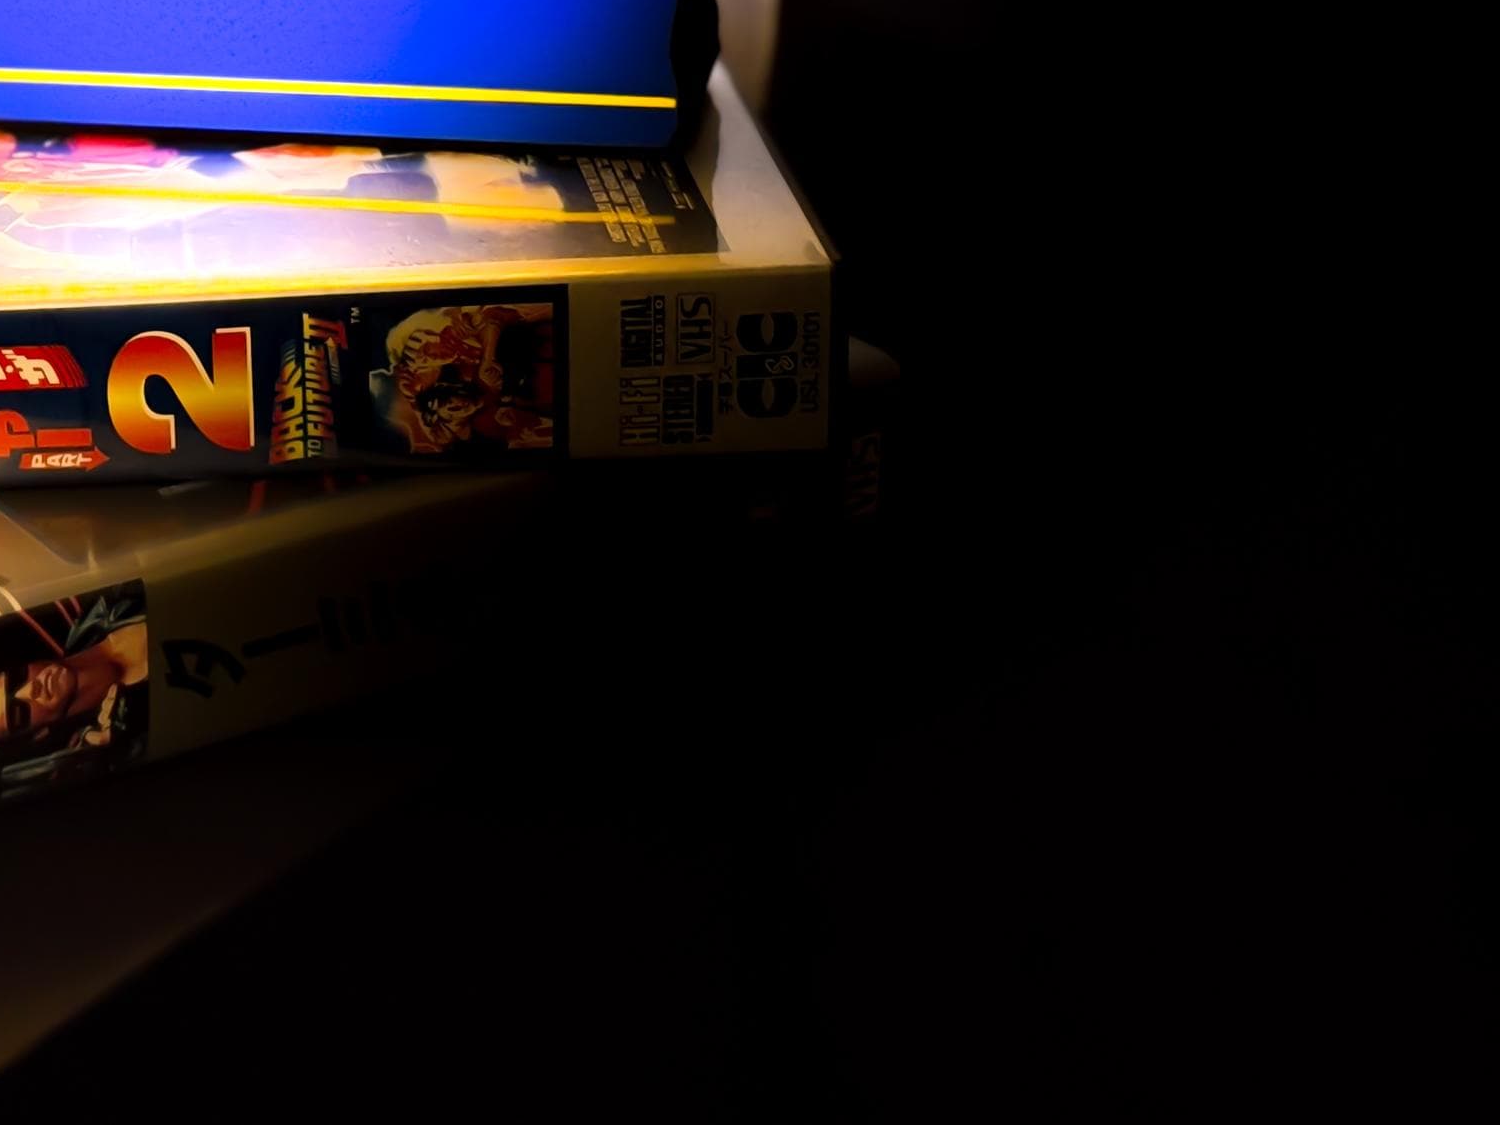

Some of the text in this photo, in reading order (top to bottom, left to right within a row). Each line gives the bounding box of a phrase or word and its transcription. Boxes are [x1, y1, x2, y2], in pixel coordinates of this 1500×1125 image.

[679, 294, 712, 362] VHS
[106, 325, 256, 455] 2
[269, 363, 305, 465] BACK
[303, 345, 336, 439] FUTURE
[802, 373, 820, 413] USL
[30, 452, 94, 469] PART
[306, 439, 323, 458] TO
